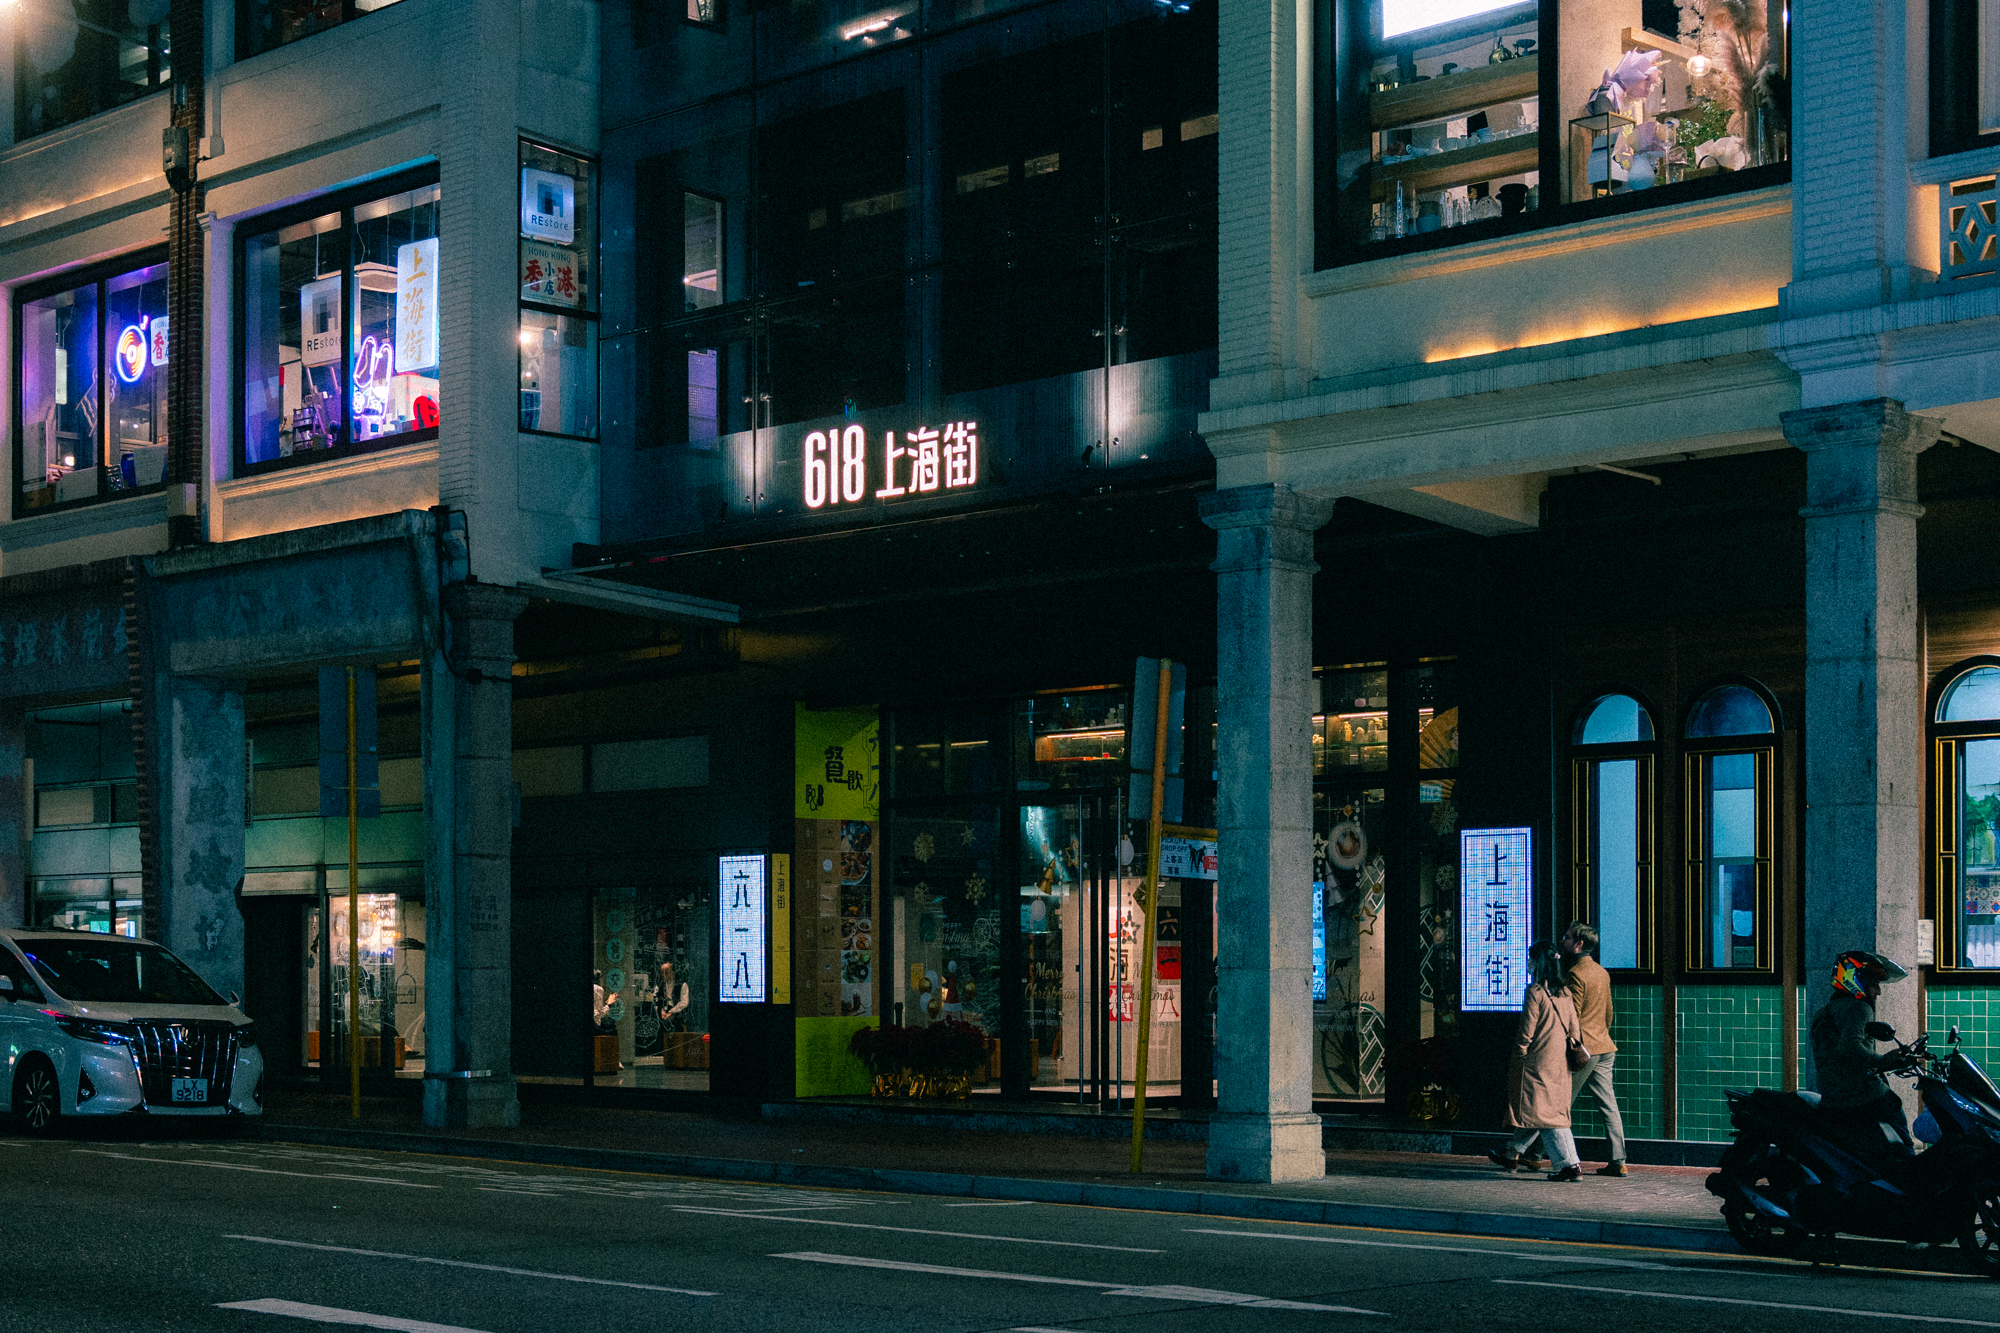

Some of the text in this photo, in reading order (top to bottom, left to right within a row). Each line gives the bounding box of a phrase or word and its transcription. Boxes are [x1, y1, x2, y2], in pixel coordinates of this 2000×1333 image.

[531, 214, 569, 231] REstore
[528, 246, 571, 263] HONG KONG
[404, 247, 427, 362] 上海街
[804, 421, 977, 509] 618 上海街
[777, 860, 786, 910] 上海街
[732, 869, 751, 989] 六一八
[1484, 843, 1510, 996] 上海街
[176, 1090, 204, 1100] 9218
[183, 1080, 198, 1090] LX
